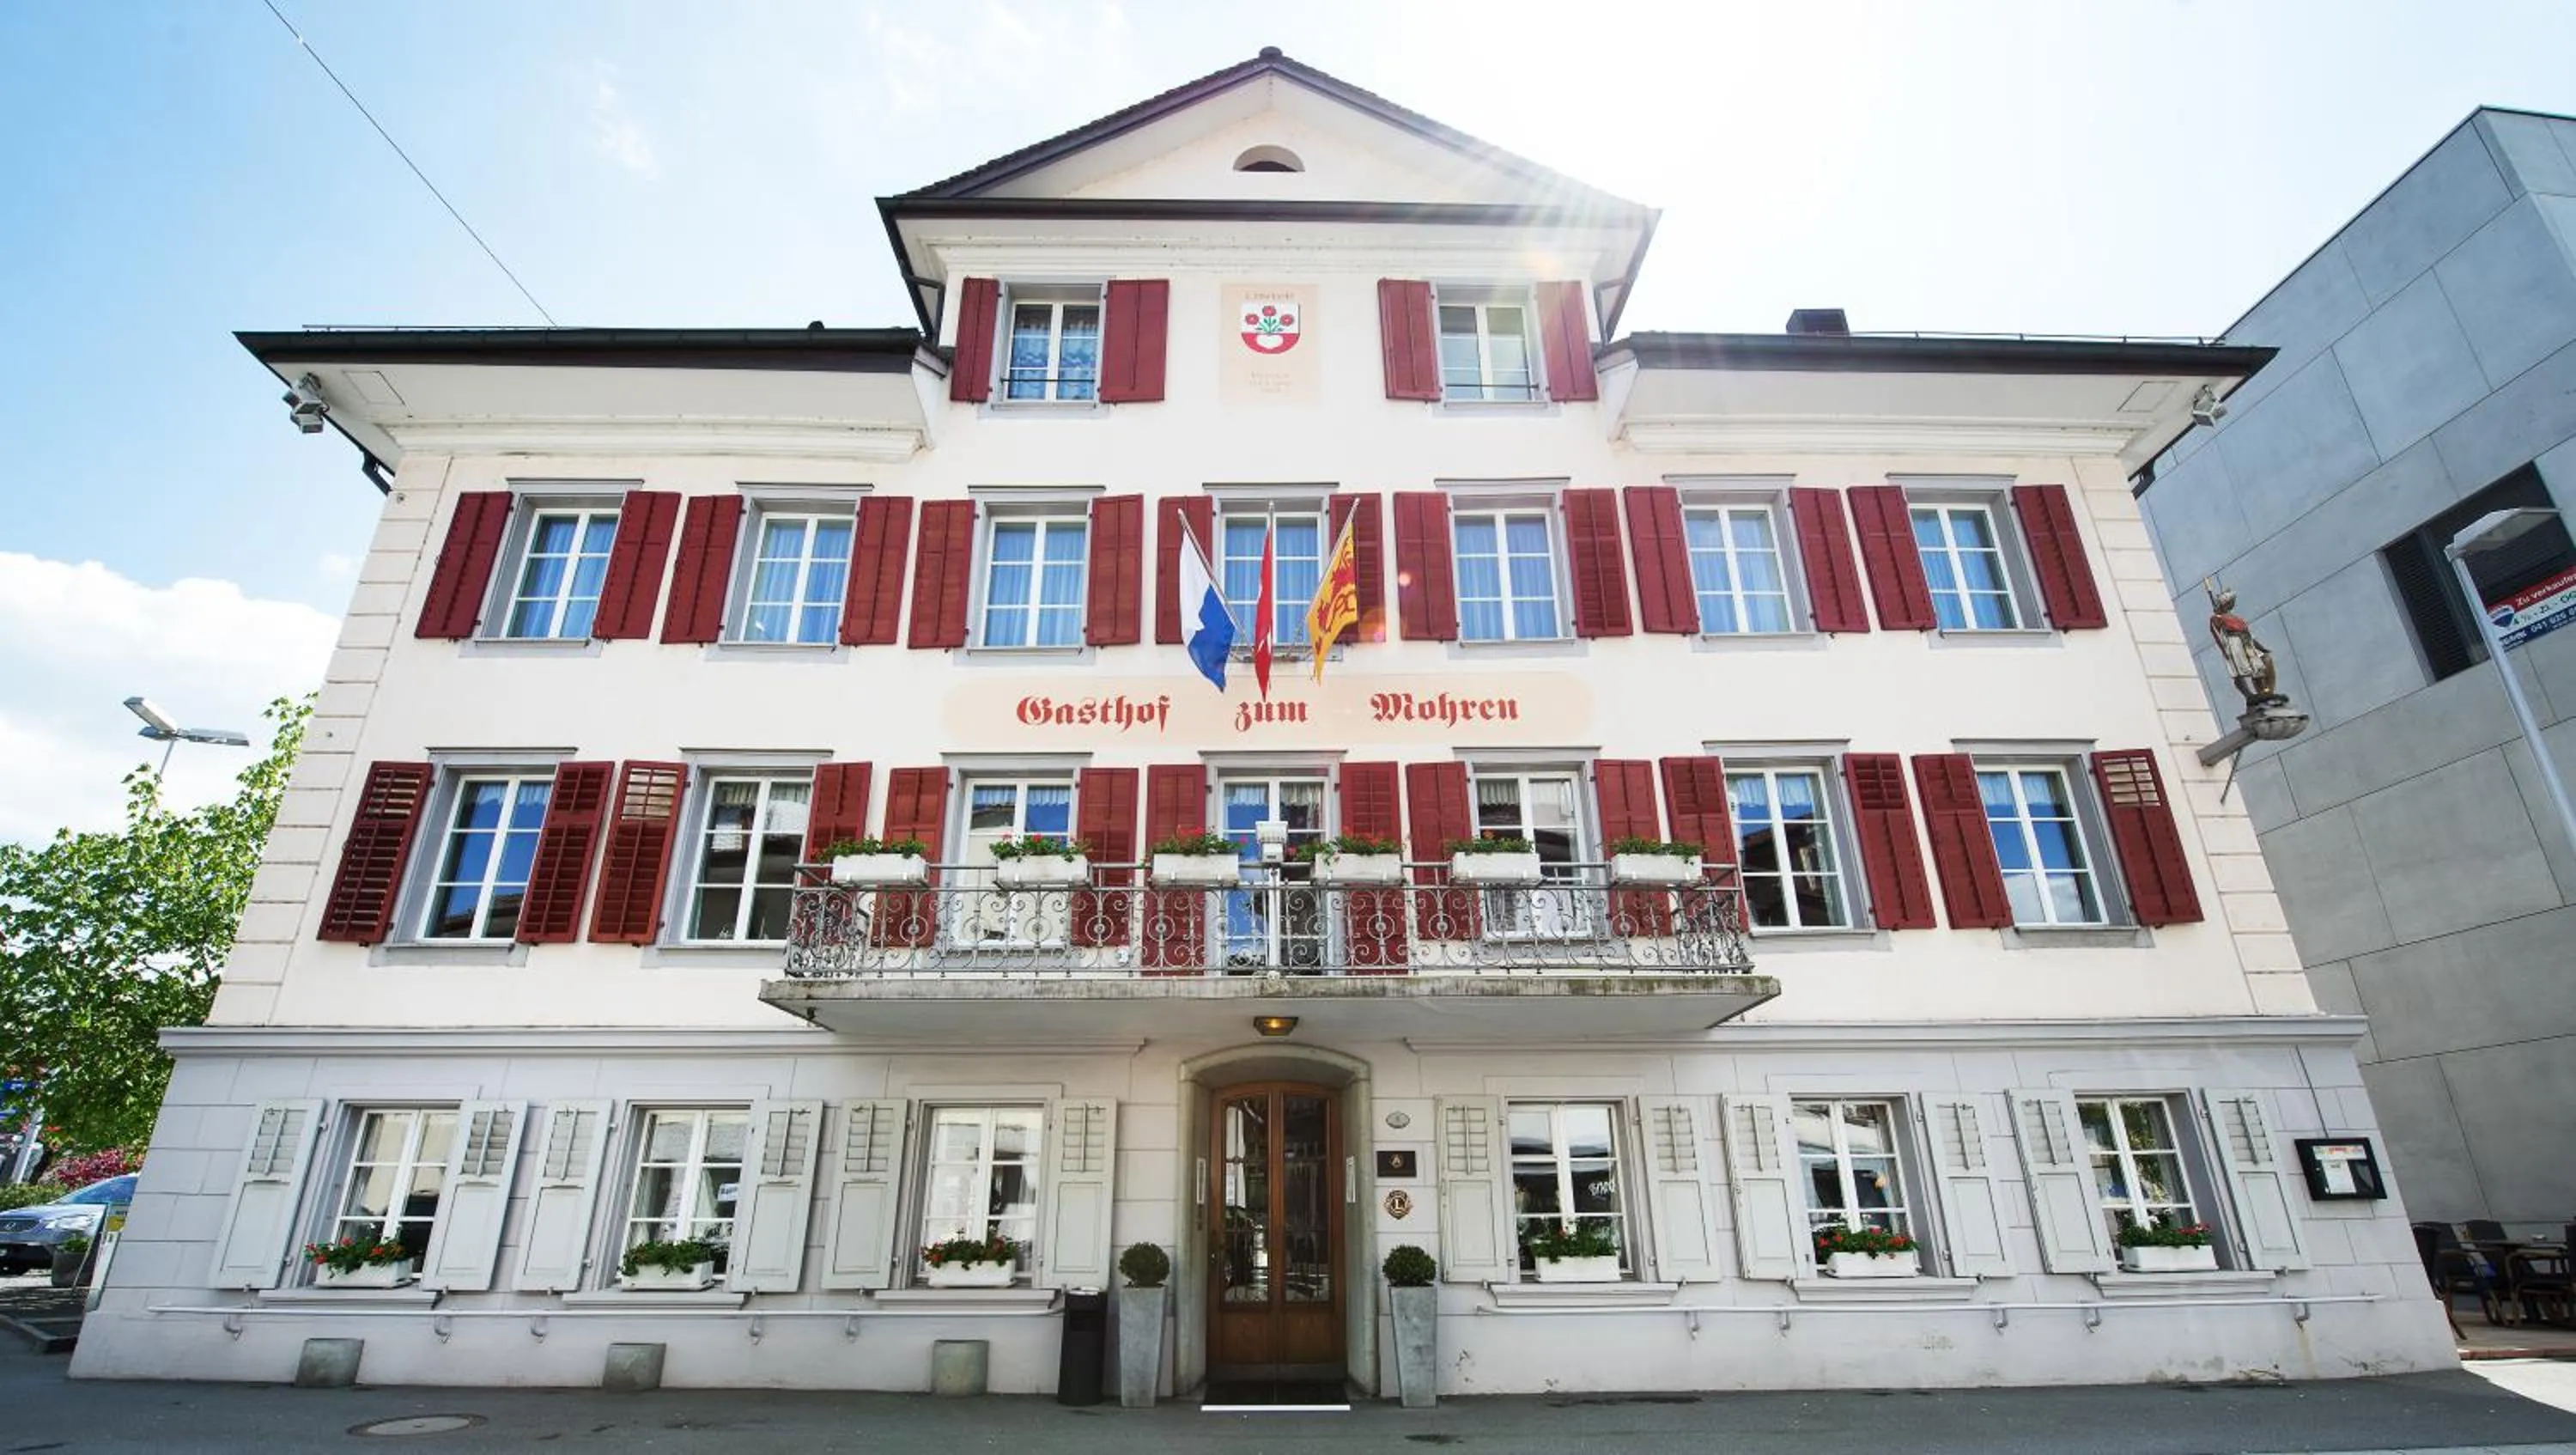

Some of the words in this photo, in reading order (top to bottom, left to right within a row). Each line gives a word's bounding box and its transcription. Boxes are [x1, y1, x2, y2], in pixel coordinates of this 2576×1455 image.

[1017, 695, 1170, 733] Gasthof
[1235, 701, 1309, 732] zum
[1370, 691, 1518, 728] Mohren
